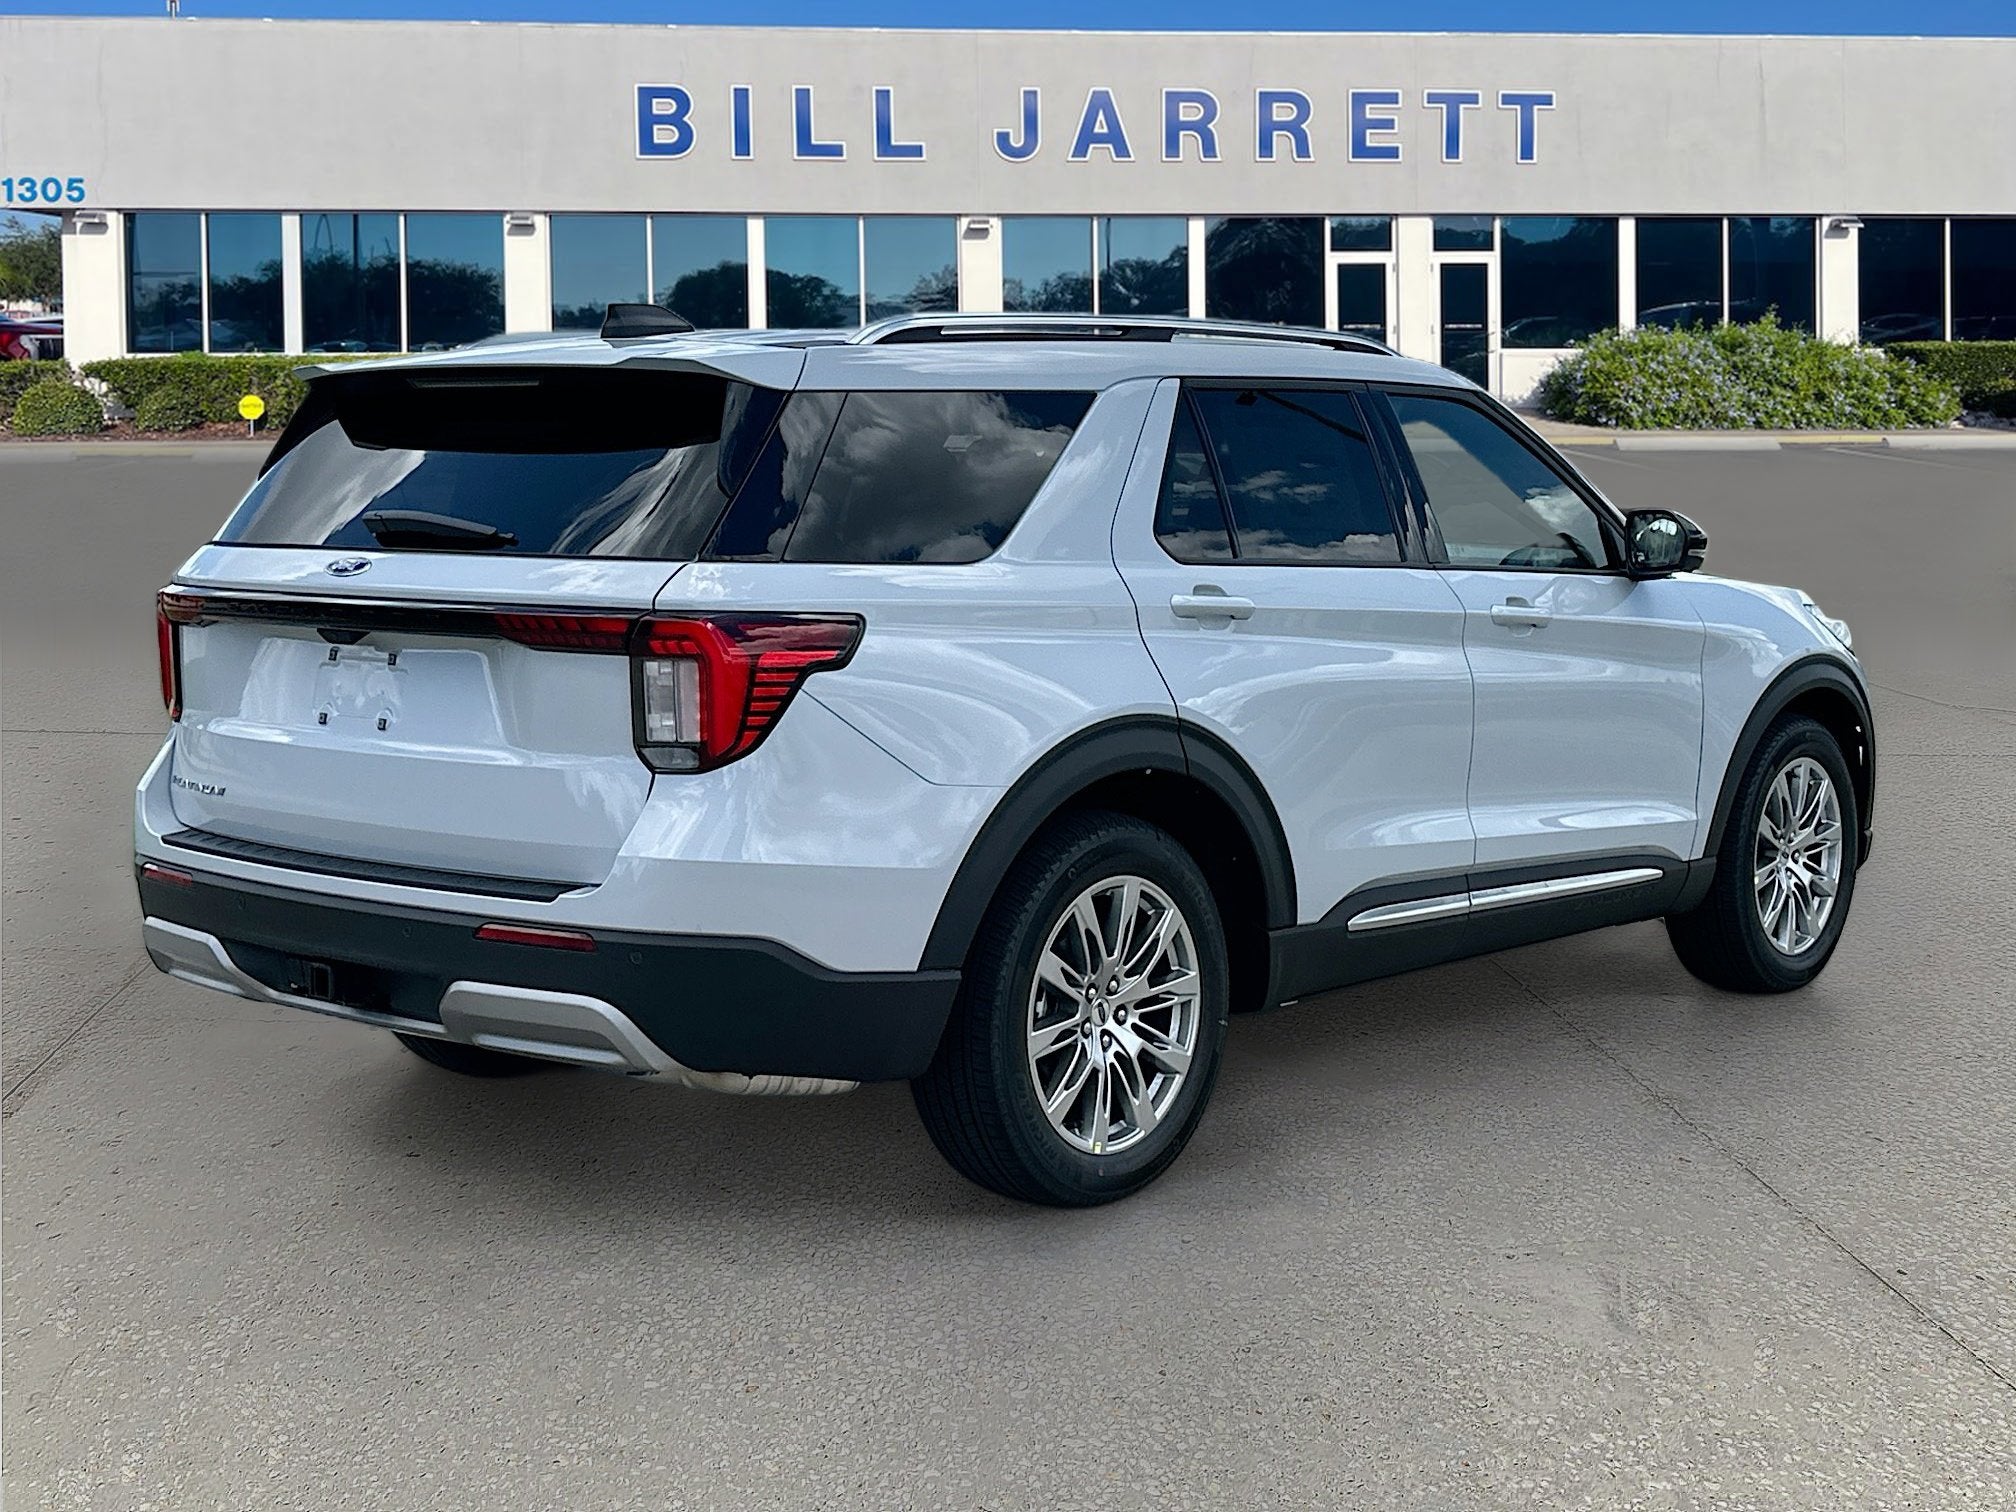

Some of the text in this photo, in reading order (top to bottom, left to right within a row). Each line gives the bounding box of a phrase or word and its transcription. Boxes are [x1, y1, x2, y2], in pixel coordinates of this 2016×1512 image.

[635, 83, 1557, 164] BILL JARRETT
[1, 176, 86, 203] 1305
